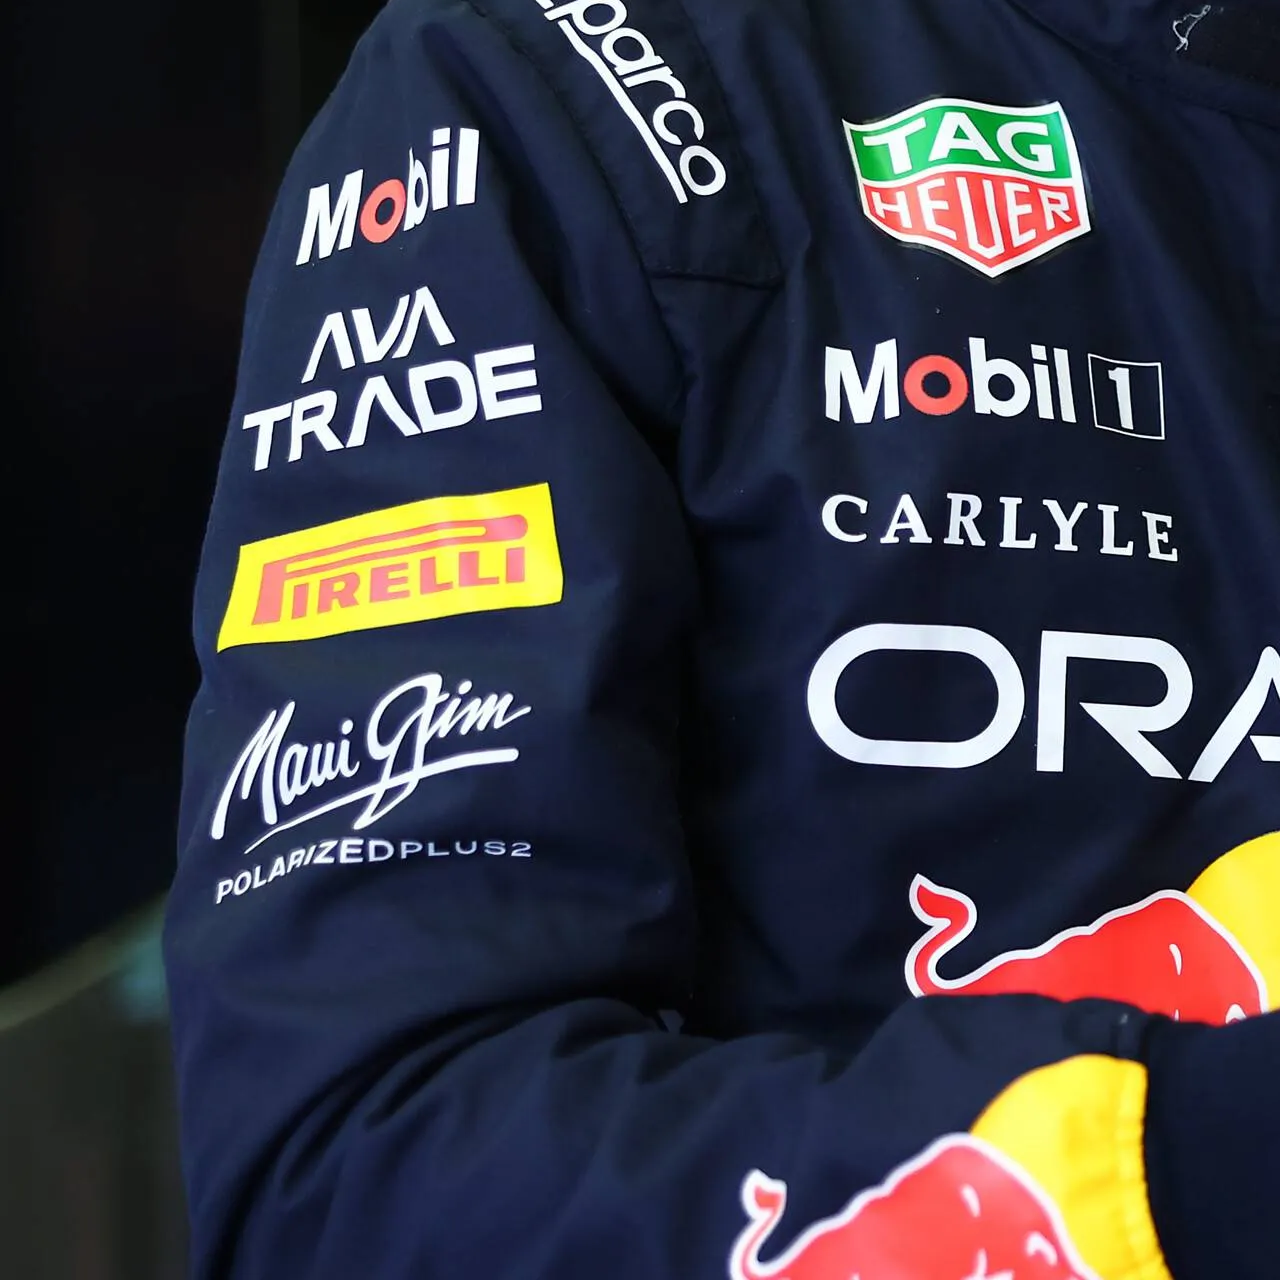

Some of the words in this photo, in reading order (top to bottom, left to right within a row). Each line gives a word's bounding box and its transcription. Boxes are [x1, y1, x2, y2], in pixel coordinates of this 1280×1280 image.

[863, 111, 1055, 176] TAG
[296, 127, 480, 266] Mobil
[872, 175, 1074, 261] HEUER
[301, 286, 456, 384] AVA
[825, 337, 1077, 424] Mobil
[242, 343, 543, 472] TRADE
[252, 515, 529, 626] PIRELLI
[821, 493, 1179, 563] CARLYLE
[211, 701, 361, 841] Maui
